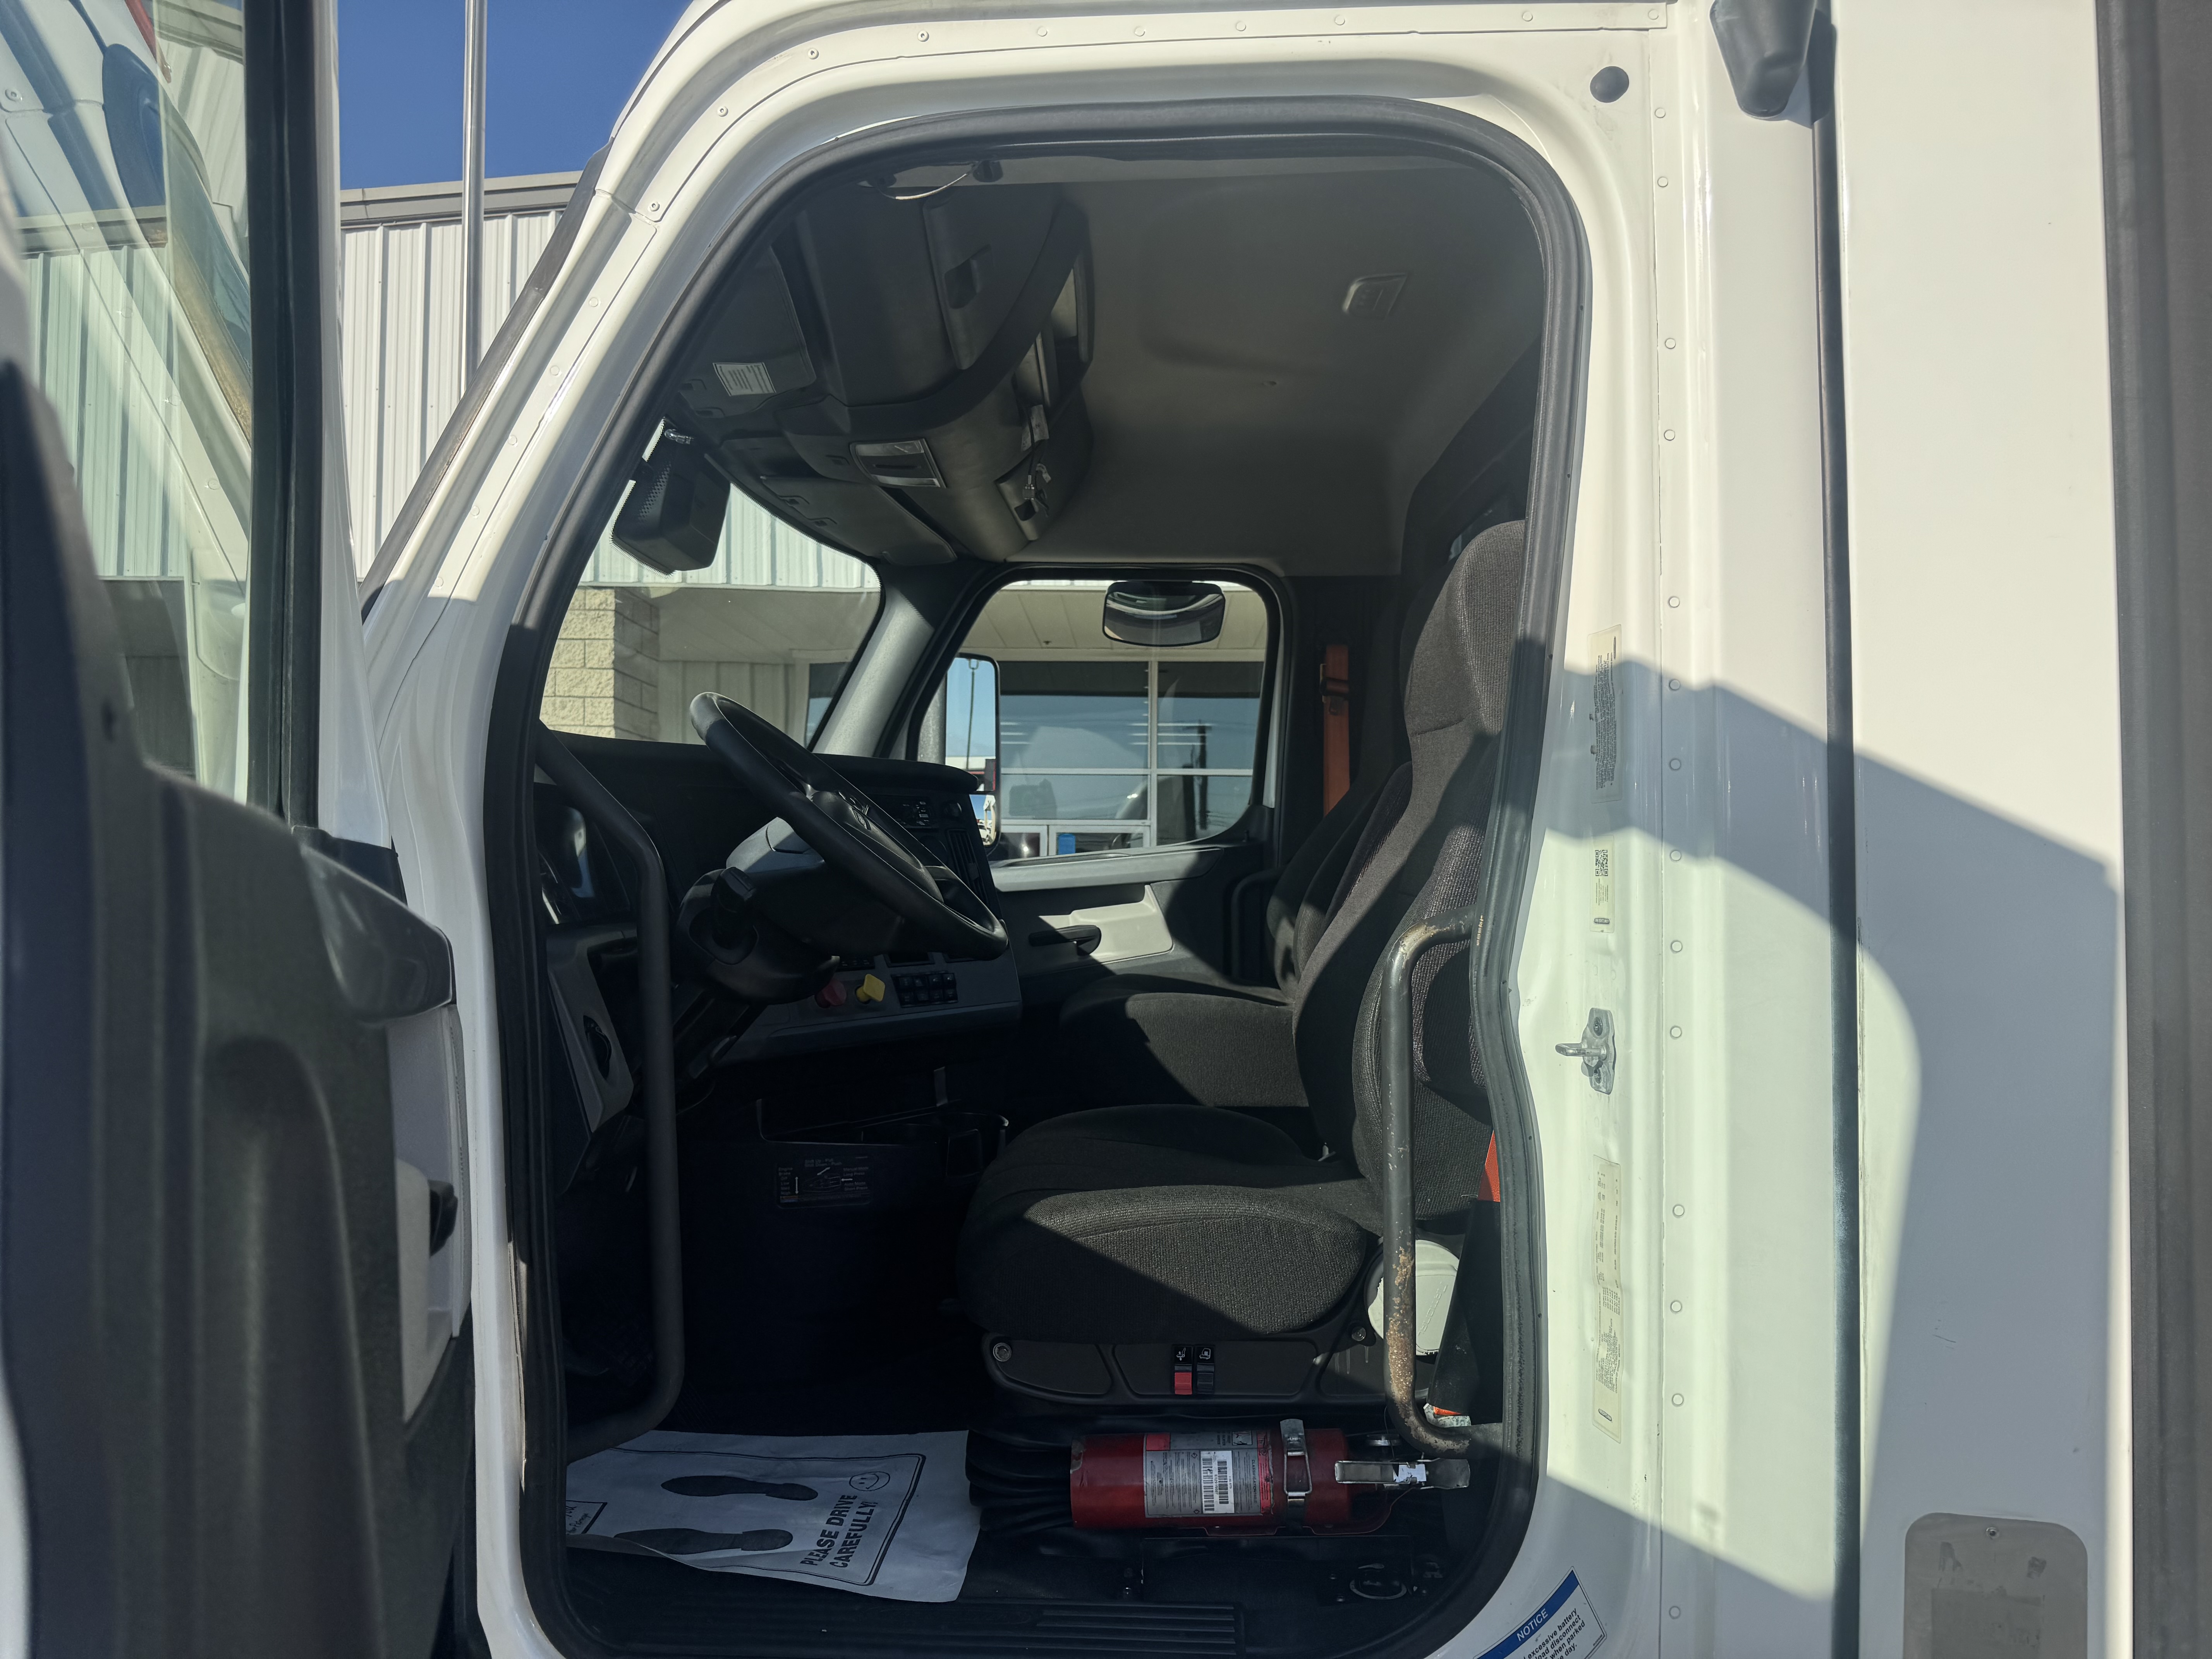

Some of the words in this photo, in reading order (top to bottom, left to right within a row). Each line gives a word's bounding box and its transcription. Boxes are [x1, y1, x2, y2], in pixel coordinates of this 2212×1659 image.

[800, 1529, 840, 1566] PLEASE
[826, 1495, 858, 1527] DRIVE
[829, 1501, 878, 1568] CAREFULLY!
[1516, 1608, 1548, 1642] NOTICE
[1528, 1630, 1558, 1659] excessive
[1557, 1608, 1577, 1632] battery
[1550, 1614, 1581, 1650] disconnect
[1550, 1642, 1566, 1659] when
[1567, 1620, 1585, 1646] parked
[1565, 1643, 1577, 1656] day.
